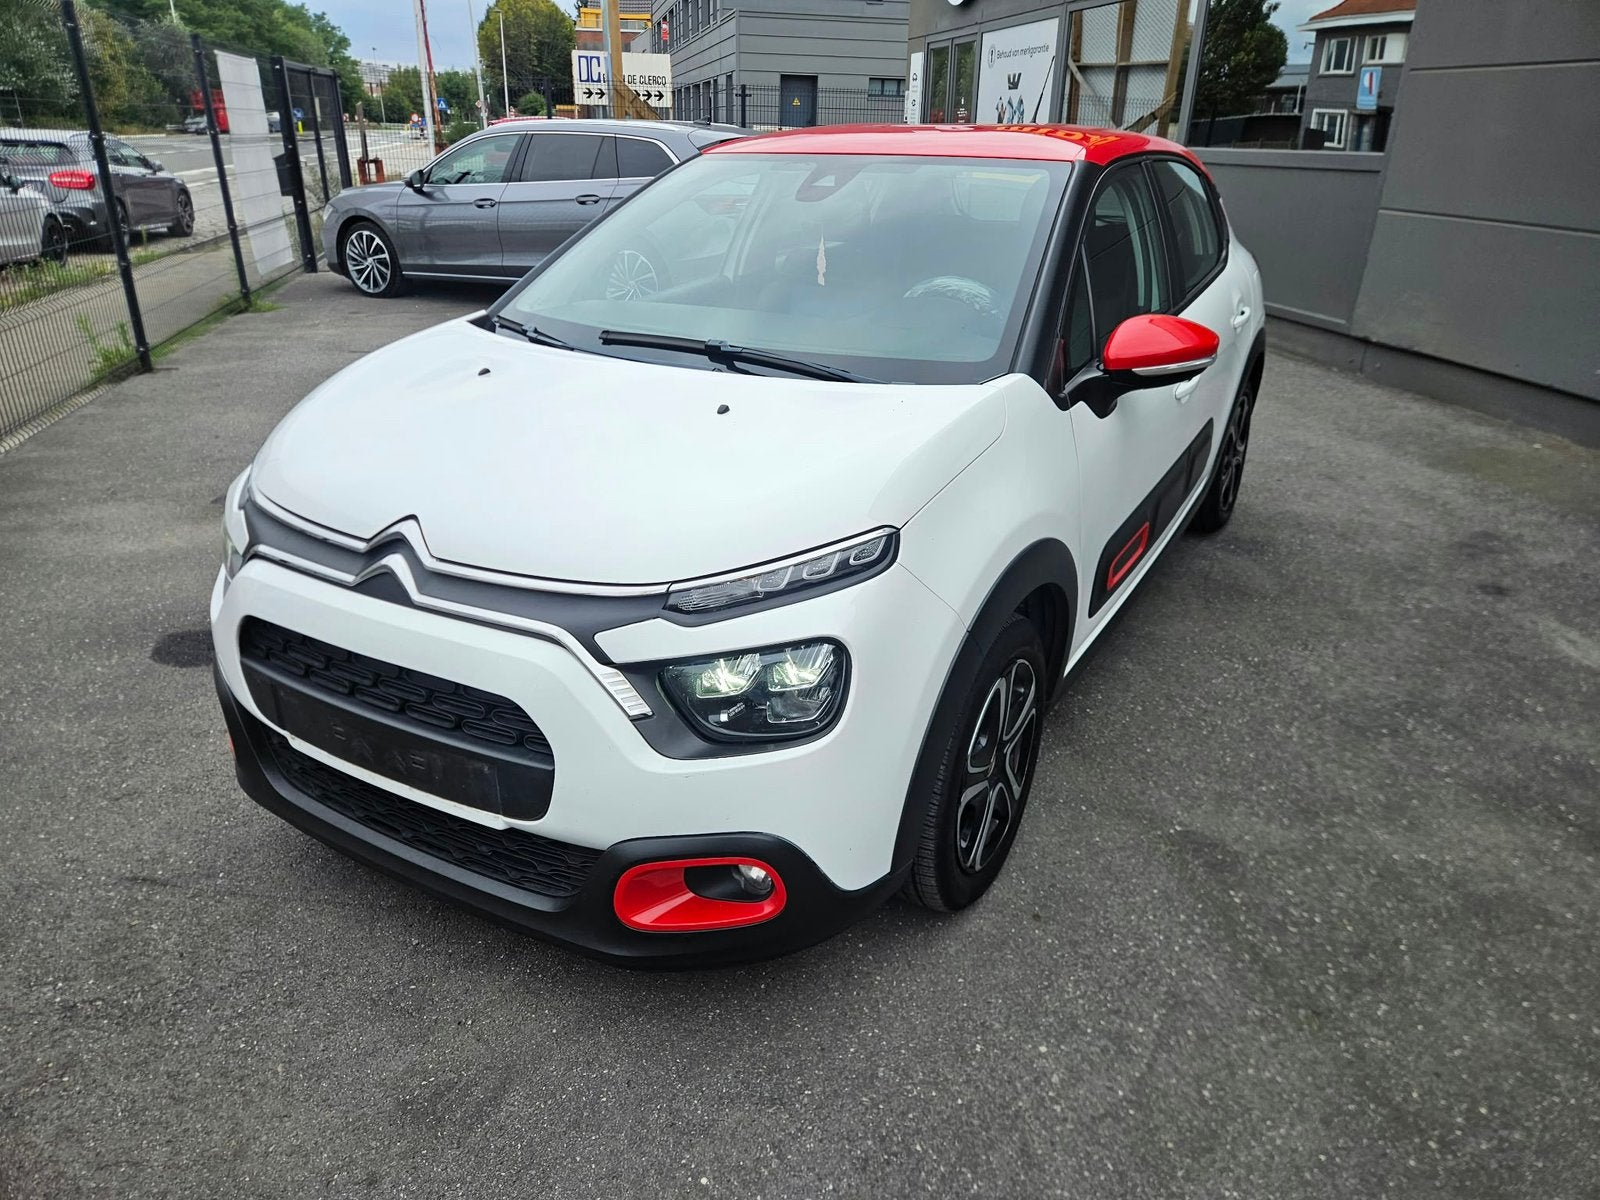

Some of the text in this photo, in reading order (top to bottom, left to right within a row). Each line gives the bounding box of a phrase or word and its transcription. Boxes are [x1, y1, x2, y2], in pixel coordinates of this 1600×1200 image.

[578, 55, 601, 83] DC
[628, 75, 637, 84] DE
[639, 75, 667, 87] CLERCQ
